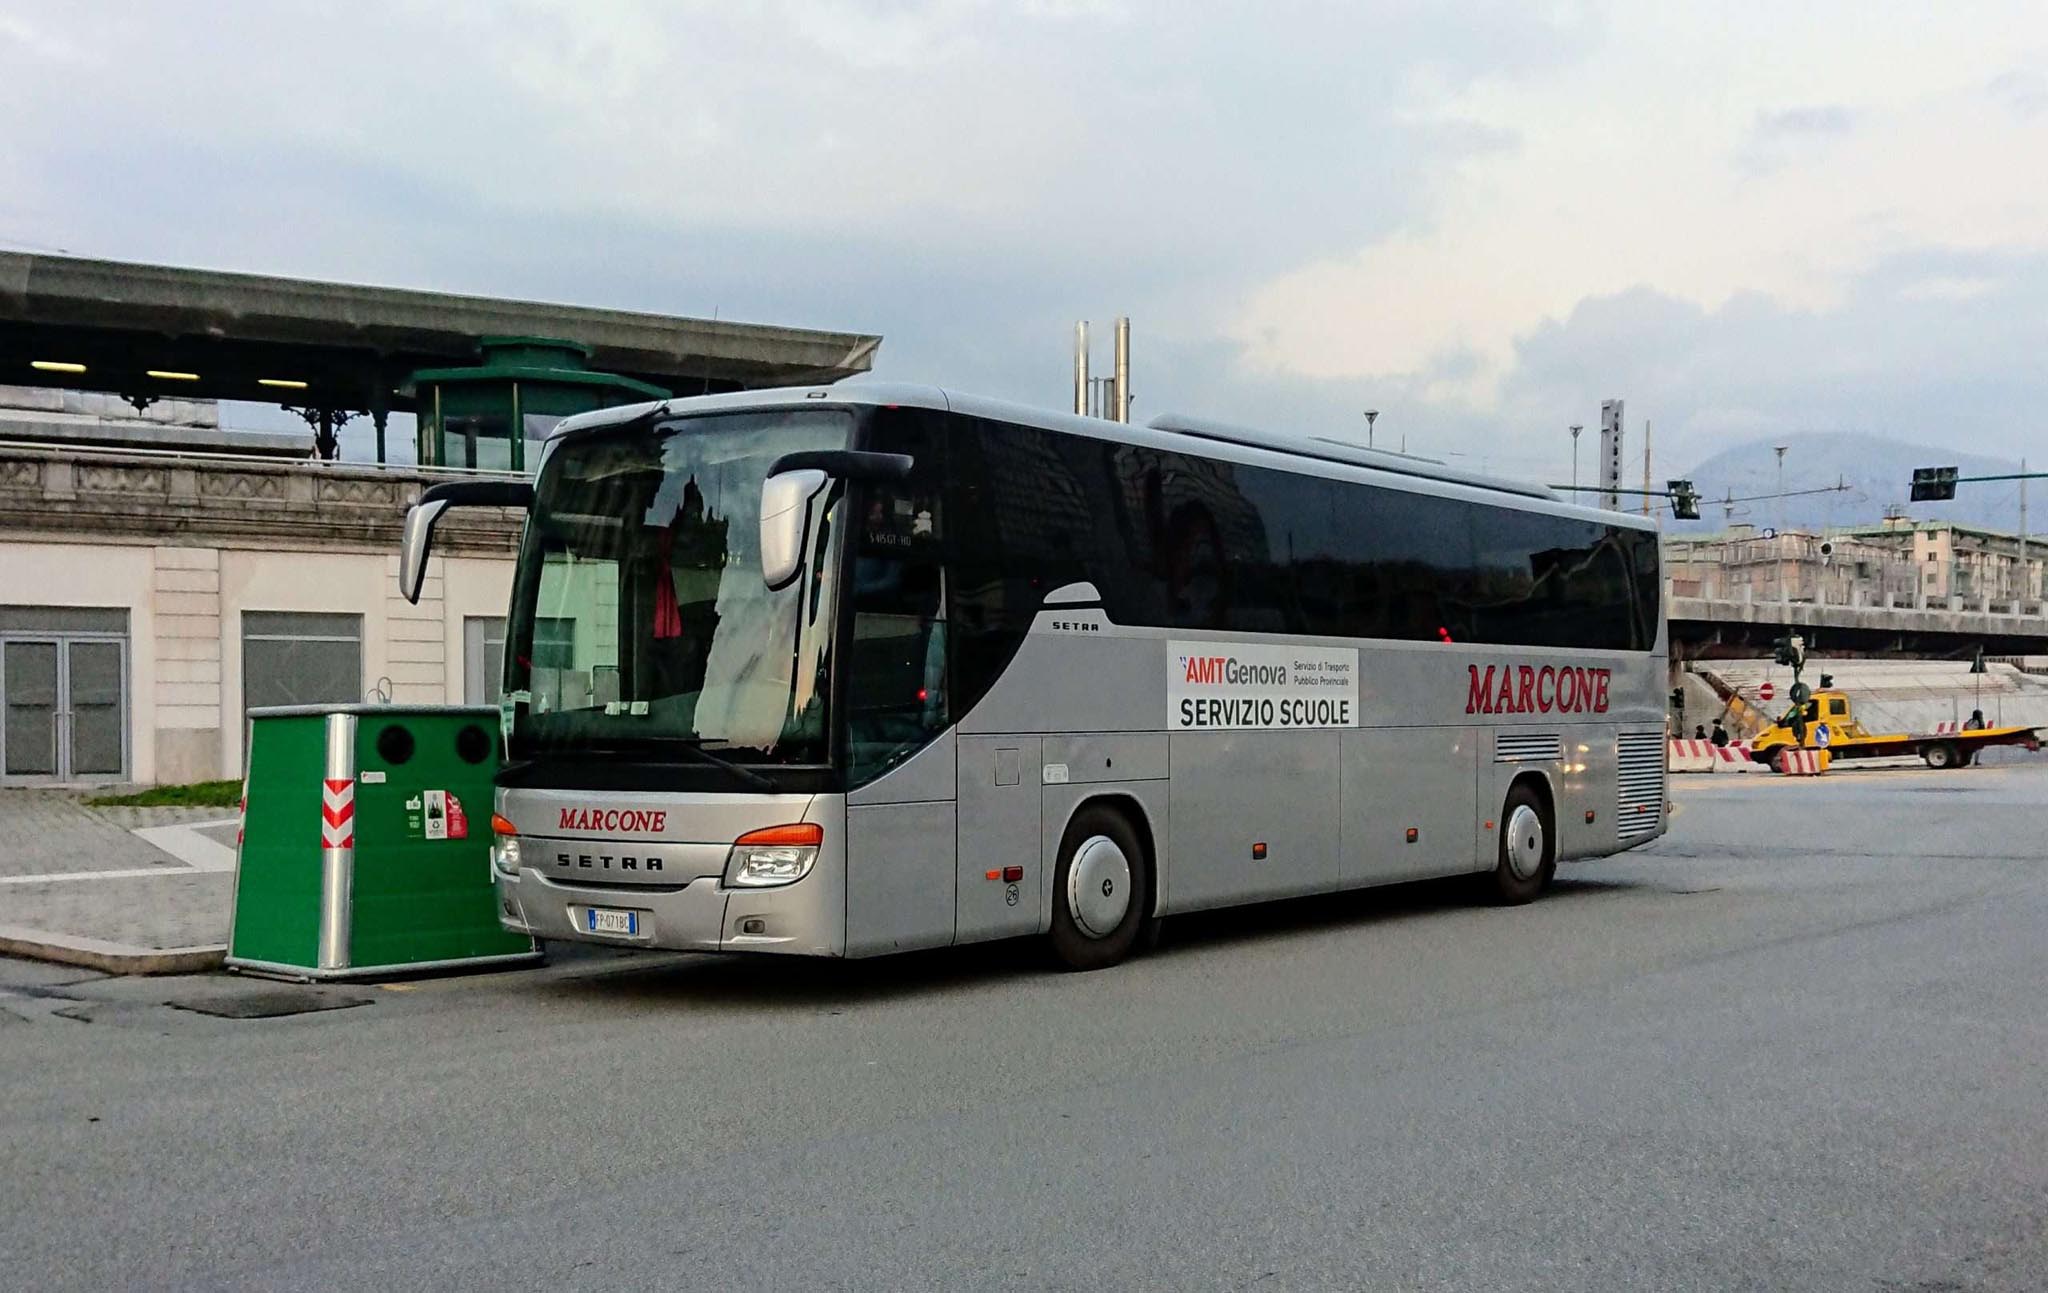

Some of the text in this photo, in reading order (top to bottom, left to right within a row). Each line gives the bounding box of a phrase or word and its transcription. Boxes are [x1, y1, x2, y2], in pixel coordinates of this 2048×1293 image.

[1052, 621, 1099, 631] SETRA
[1293, 660, 1350, 673] Servizio di Trasporto
[1293, 675, 1349, 687] Pubblico Provinciale
[1465, 664, 1612, 714] MARCONE
[1180, 698, 1350, 726] SERVIZIO SCUOLE
[558, 808, 667, 832] MARCONE
[557, 854, 663, 871] SETRA
[1007, 889, 1018, 902] 26
